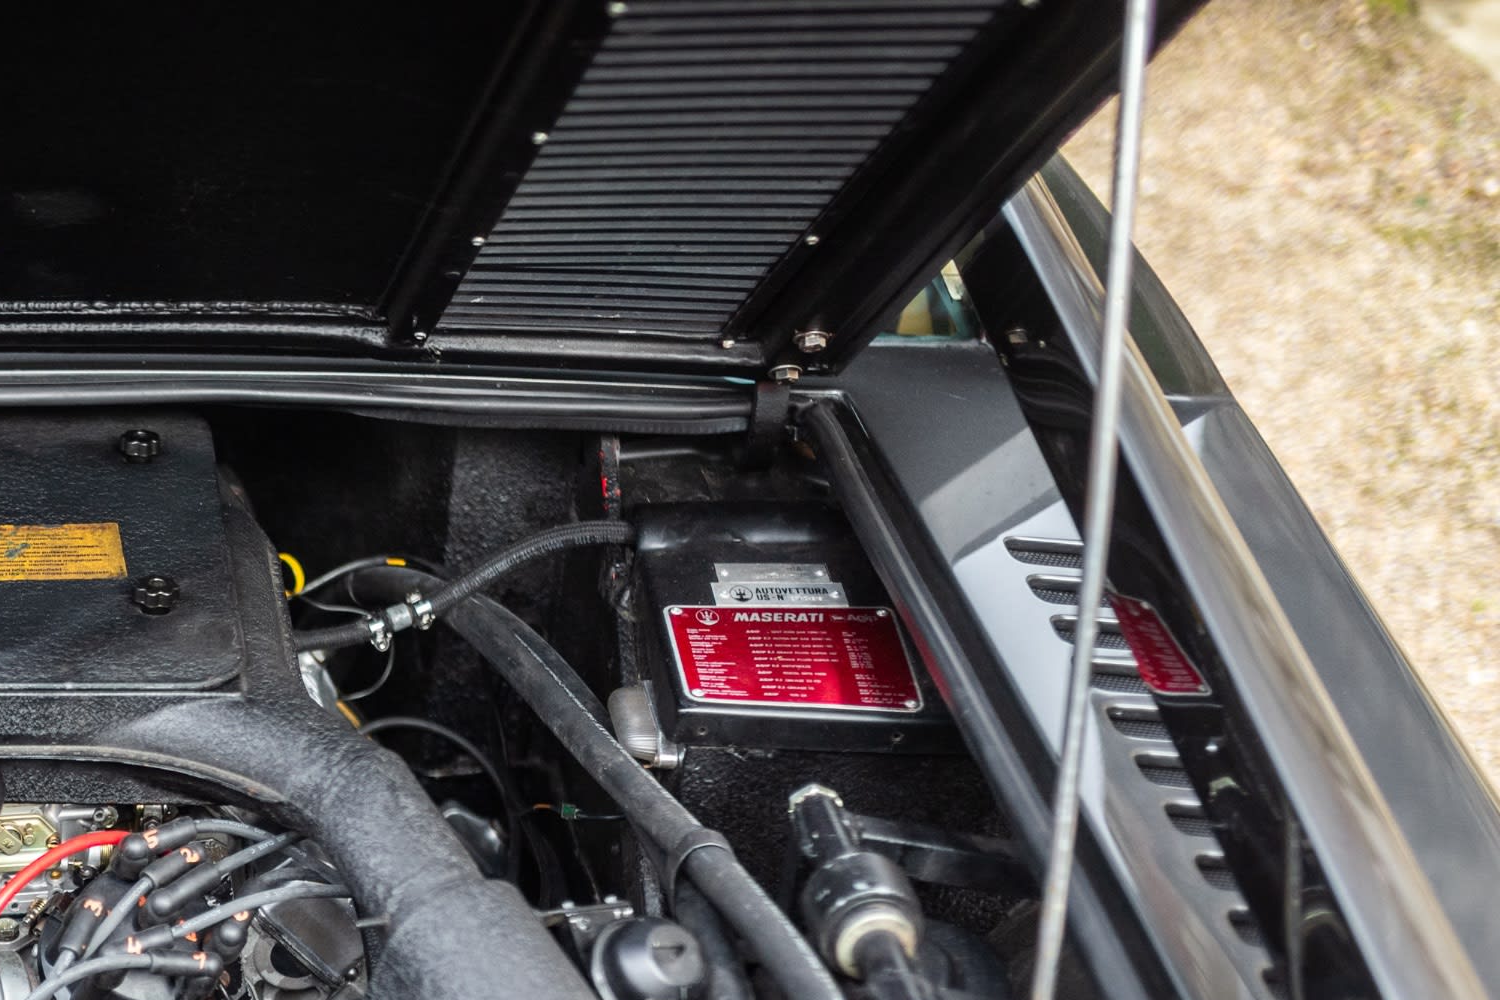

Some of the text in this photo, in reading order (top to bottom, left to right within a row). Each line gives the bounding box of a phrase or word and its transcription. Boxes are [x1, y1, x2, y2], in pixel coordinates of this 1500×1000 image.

[755, 587, 829, 595] AUTOVETTURA
[734, 612, 824, 623] MASERATI
[143, 828, 159, 849] 5
[180, 847, 200, 864] 2
[83, 899, 103, 917] 3
